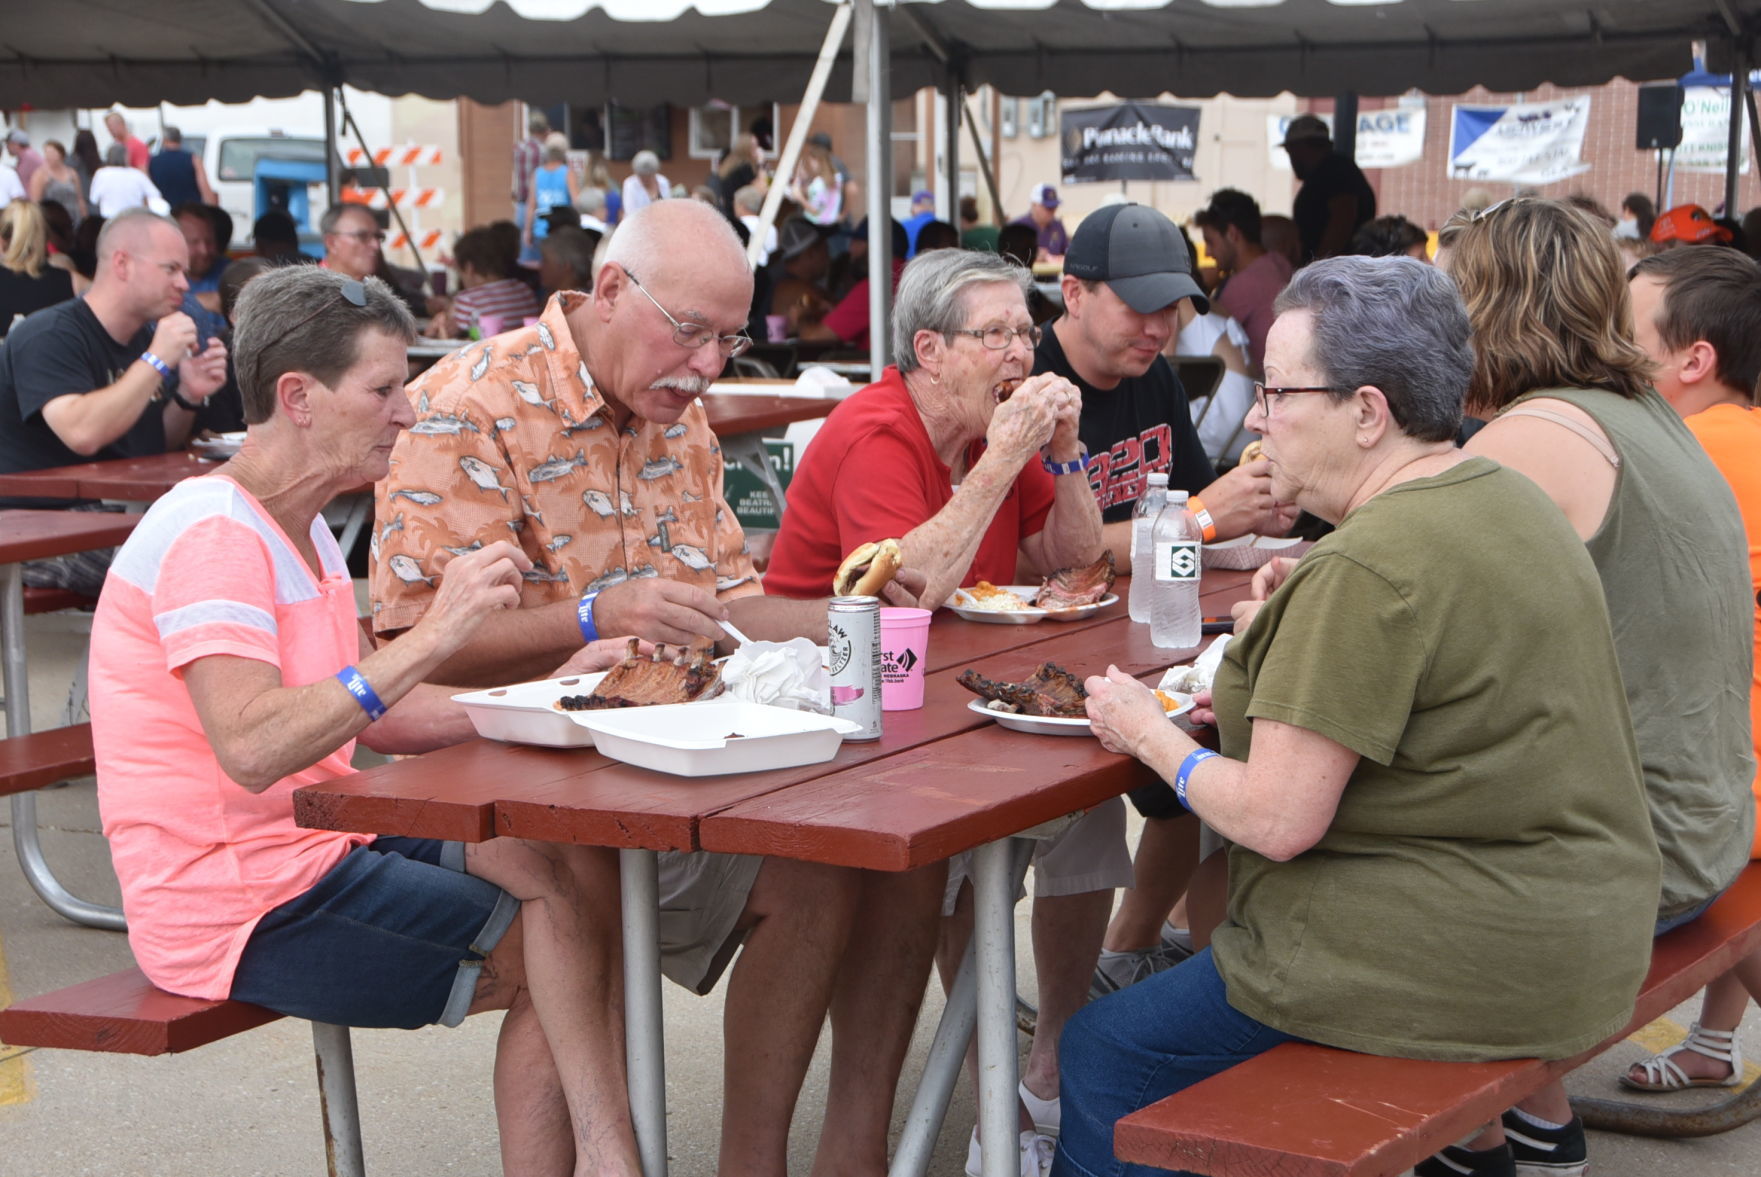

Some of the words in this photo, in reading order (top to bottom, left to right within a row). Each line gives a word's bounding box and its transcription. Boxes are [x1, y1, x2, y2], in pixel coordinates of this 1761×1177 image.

[750, 490, 768, 499] KEE
[736, 506, 774, 515] BEAUTIF
[829, 619, 848, 639] LAW
[880, 662, 899, 673] ate
